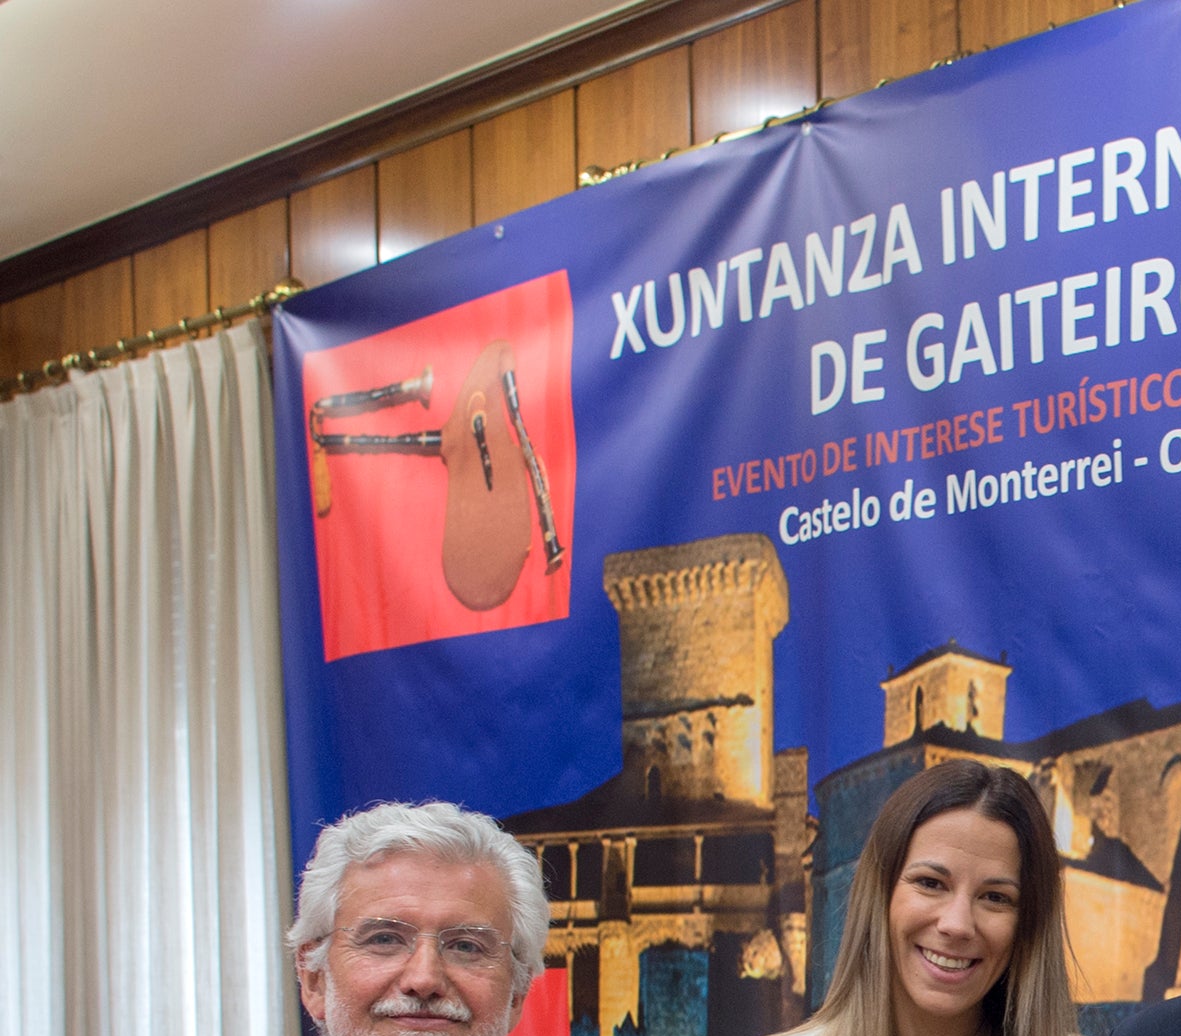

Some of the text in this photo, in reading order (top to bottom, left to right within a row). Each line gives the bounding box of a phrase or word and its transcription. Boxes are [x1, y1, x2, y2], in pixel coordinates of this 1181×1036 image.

[609, 203, 923, 360] XUNTANZA
[810, 329, 887, 415] DE
[712, 448, 817, 501] EVENTO
[822, 437, 857, 477] DE
[865, 407, 1004, 468] INTERESE
[779, 487, 881, 546] Castelo
[889, 479, 936, 521] de
[946, 438, 1123, 515] Monterrei
[1133, 455, 1149, 467] -
